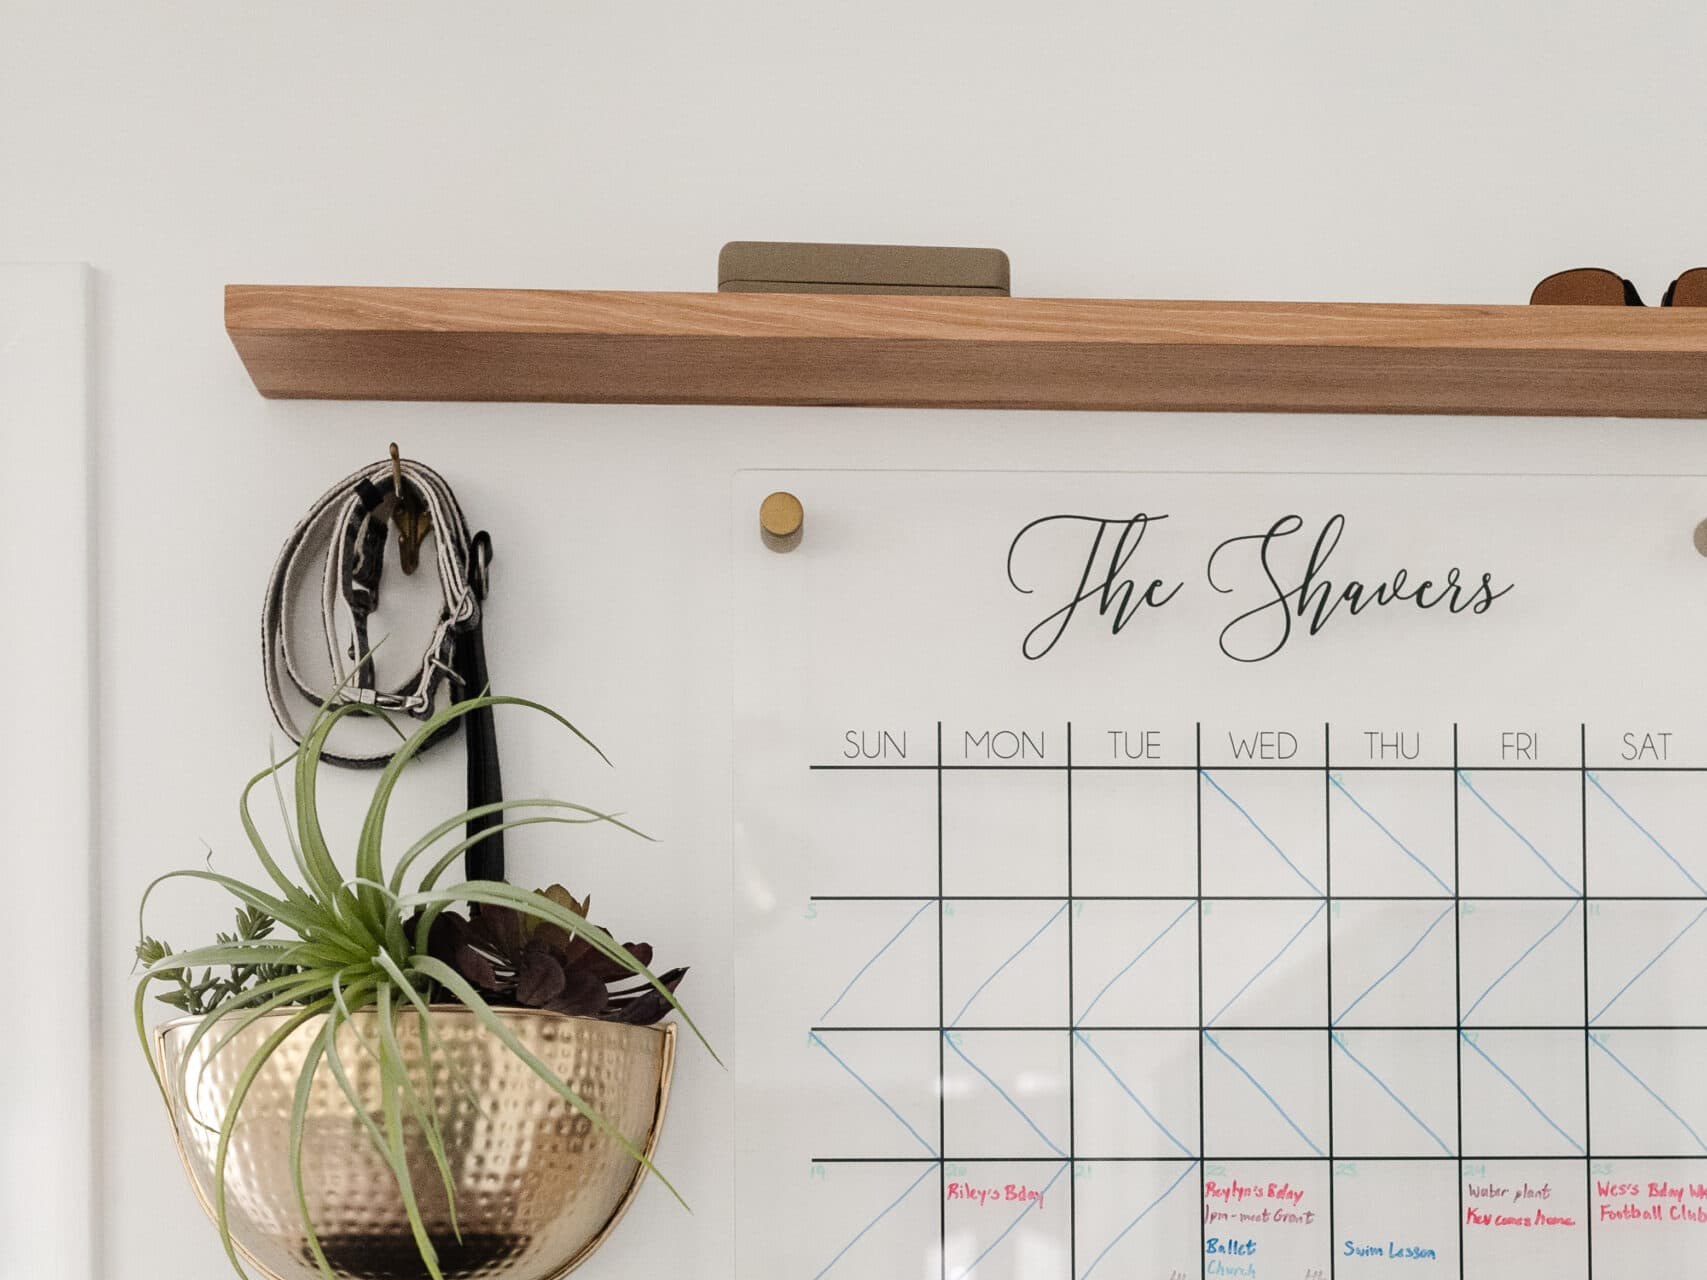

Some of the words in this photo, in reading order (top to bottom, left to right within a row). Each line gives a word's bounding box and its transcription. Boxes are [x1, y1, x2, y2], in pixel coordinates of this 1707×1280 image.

[1008, 513, 1184, 660] The
[1208, 514, 1514, 662] Shavers
[843, 730, 907, 759] SUN
[965, 731, 1045, 759] MON
[1108, 731, 1161, 759] TUE
[1229, 731, 1298, 759] WED
[1364, 731, 1420, 760] THU
[1502, 732, 1538, 760] FRI
[1621, 732, 1673, 760] SAT
[947, 1183, 1000, 1206] Riley's
[1004, 1185, 1044, 1209] Bday
[1267, 1183, 1304, 1207] Bday
[1468, 1183, 1509, 1199] Water
[1512, 1183, 1552, 1204] plant
[1597, 1180, 1640, 1198] Wes's
[1647, 1181, 1684, 1203] Bday
[1273, 1208, 1315, 1225] Grant
[1600, 1203, 1663, 1222] Football
[1669, 1204, 1707, 1223] Club
[1205, 1237, 1257, 1256] Ballet
[1343, 1240, 1384, 1258] Swim
[1388, 1242, 1437, 1261] Lesson
[1207, 1259, 1257, 1279] Church
